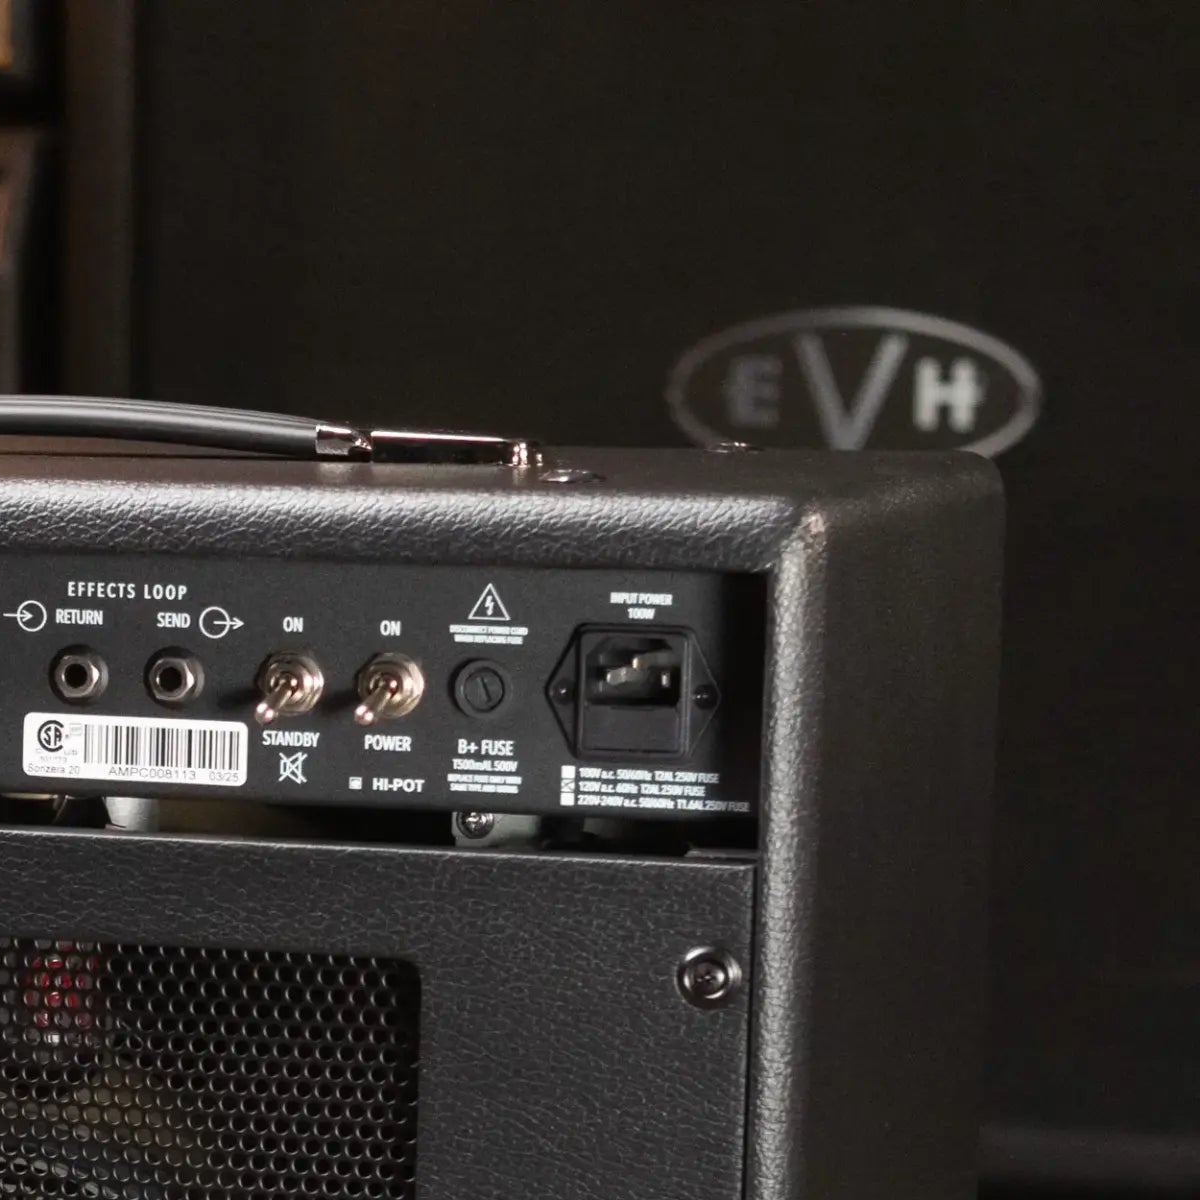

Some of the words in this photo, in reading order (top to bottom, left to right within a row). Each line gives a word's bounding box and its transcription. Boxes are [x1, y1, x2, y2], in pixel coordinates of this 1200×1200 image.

[725, 332, 984, 450] EVH
[67, 581, 136, 599] EFFECTS
[143, 584, 187, 600] LOOP
[55, 608, 104, 625] RETURN
[156, 612, 191, 629] SEND
[282, 616, 303, 632] ON
[380, 620, 401, 636] ON
[262, 730, 320, 748] STANDBY
[364, 734, 412, 752] POWER
[458, 738, 479, 754] B+
[481, 739, 514, 756] FUSE
[69, 765, 80, 775] 20
[108, 766, 197, 781] AMPC008113
[208, 771, 239, 782] 03/25
[698, 773, 720, 783] FUSE
[372, 777, 425, 793] HI-POT
[683, 786, 706, 796] FUSE
